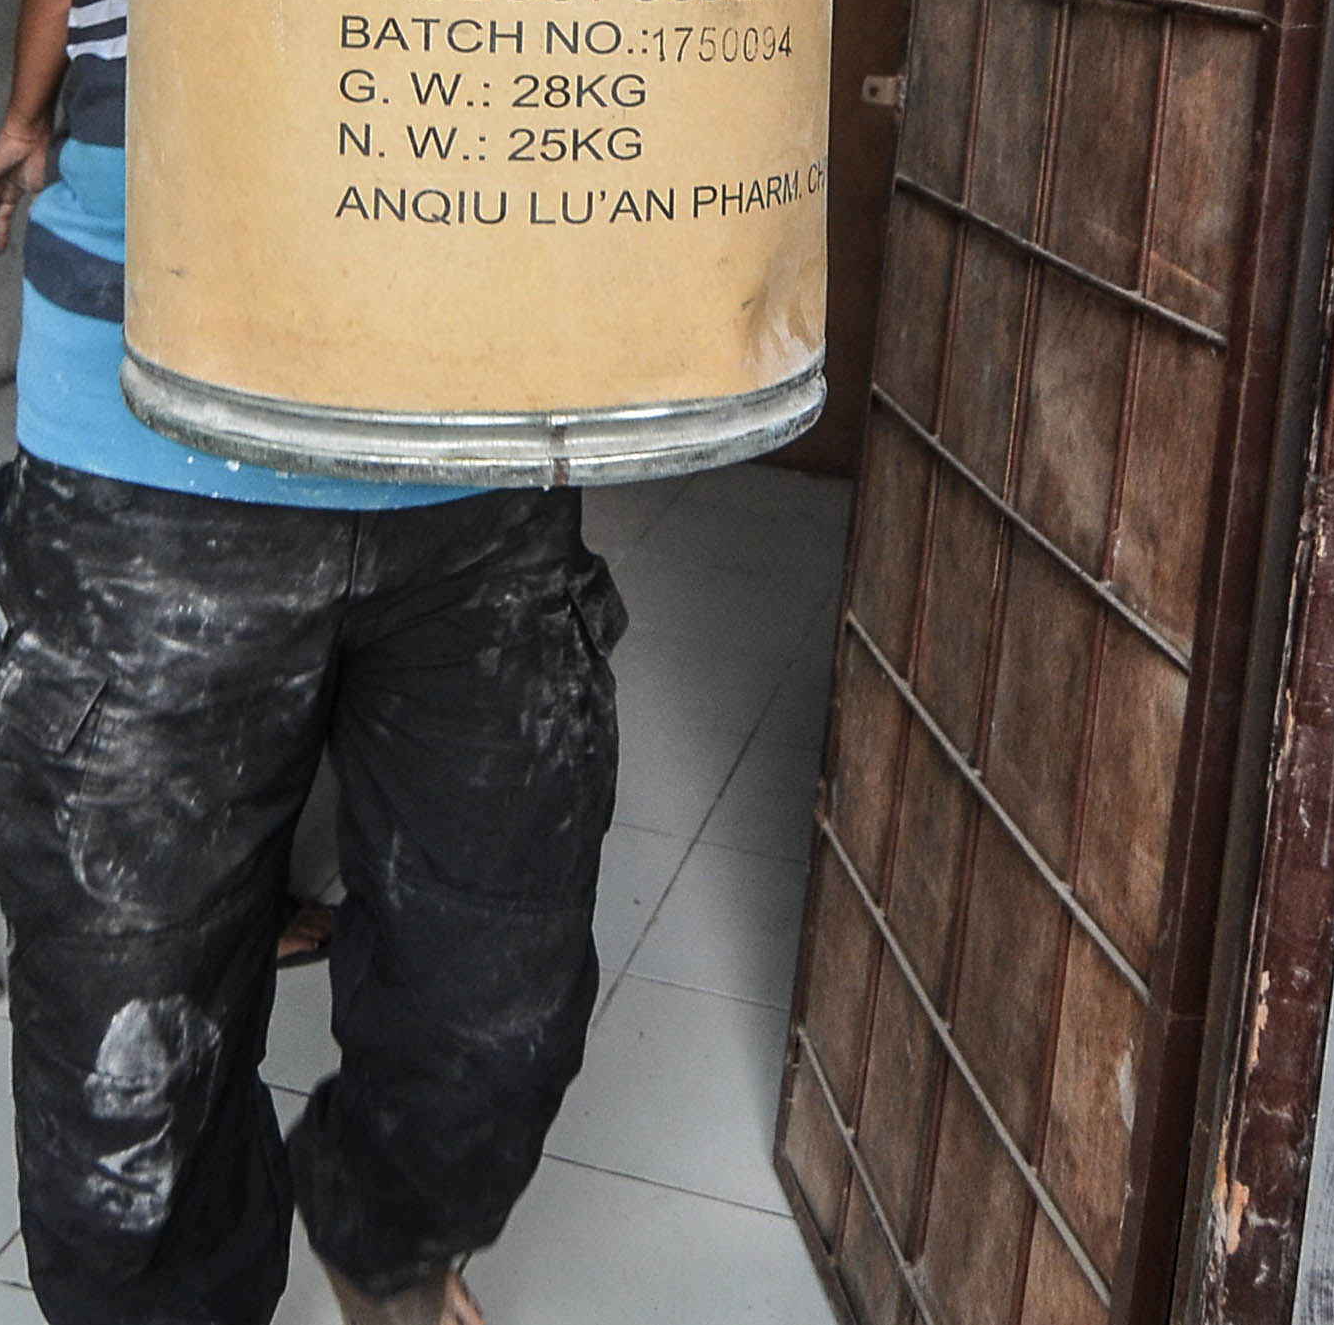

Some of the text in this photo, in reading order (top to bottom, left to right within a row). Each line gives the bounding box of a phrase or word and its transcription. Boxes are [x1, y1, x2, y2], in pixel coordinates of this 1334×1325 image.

[340, 14, 524, 55] BATCH
[339, 68, 646, 109] G. W.: 28KG
[339, 121, 642, 163] N. W.: 25KG
[334, 185, 507, 227] ANQIU
[692, 169, 803, 220] PHARM.
